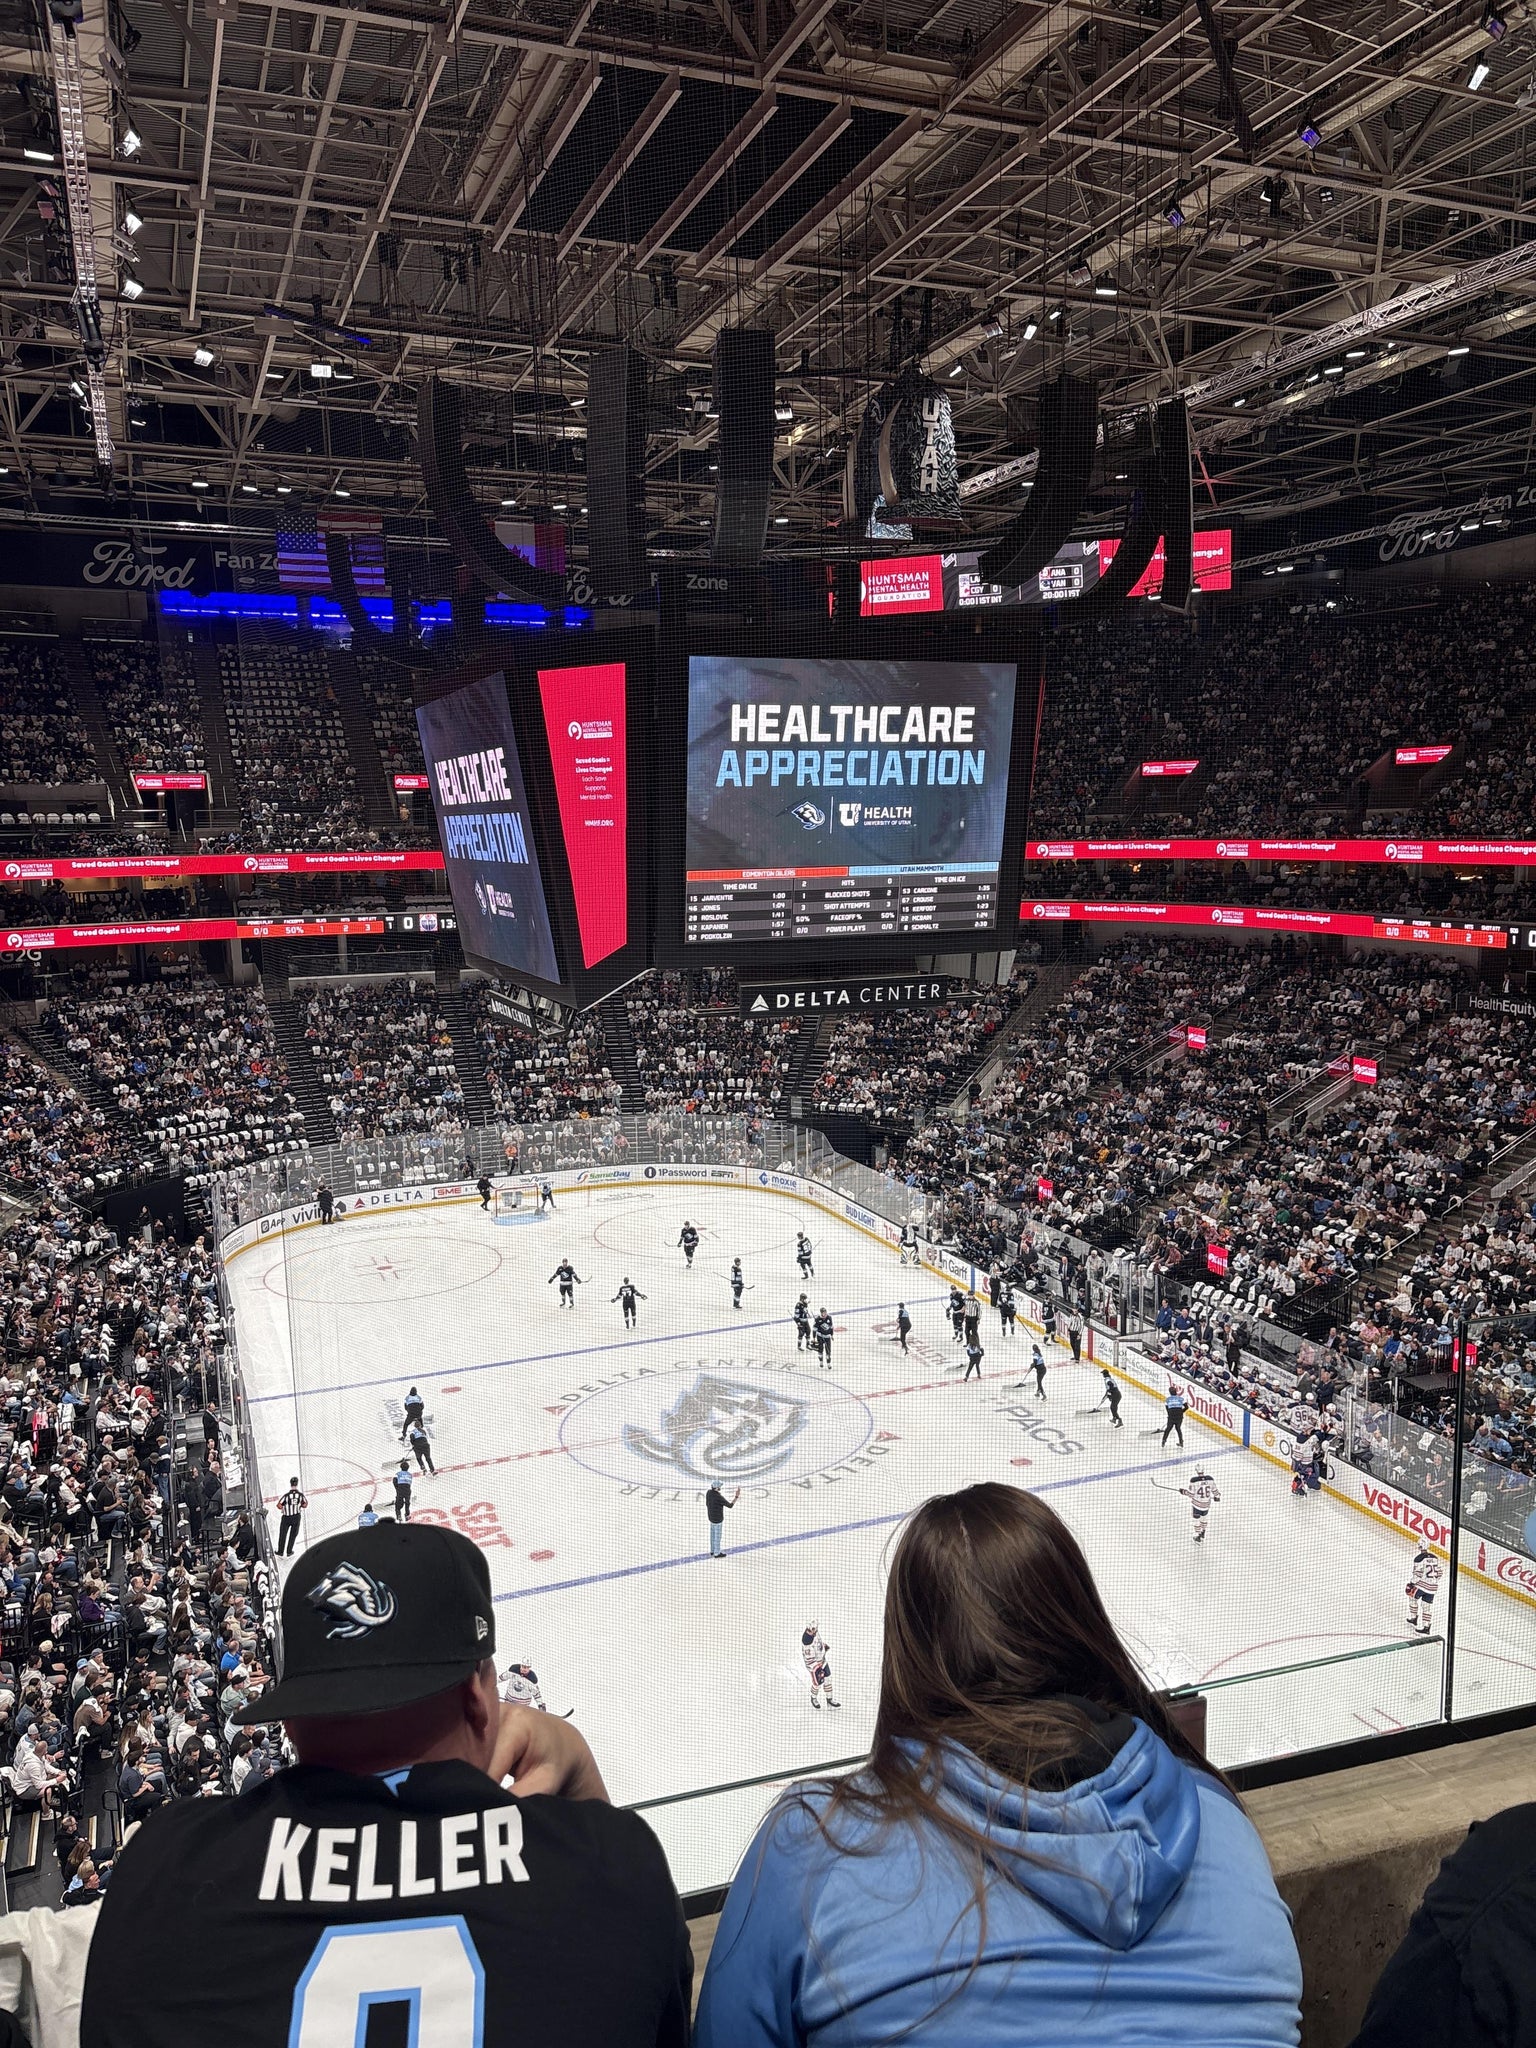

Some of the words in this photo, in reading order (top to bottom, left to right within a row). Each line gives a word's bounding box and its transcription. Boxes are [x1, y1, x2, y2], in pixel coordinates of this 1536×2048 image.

[920, 398, 940, 494] UTAH
[83, 541, 196, 588] Ford
[214, 551, 254, 569] Fan
[686, 574, 728, 590] Zone
[868, 572, 929, 585] HUNTSMAN
[869, 585, 898, 594] MENTAL
[900, 582, 929, 591] HEALTH
[731, 704, 975, 742] HEALTHCARE
[434, 747, 512, 806] HEALTHCARE
[716, 750, 985, 787] APPRECIATION
[864, 806, 912, 818] HEALTH
[444, 812, 529, 864] APPRECIATION
[1311, 843, 1336, 852] Changed
[1485, 845, 1503, 853] Lives
[145, 859, 179, 868] Changed
[373, 854, 404, 863] Changed
[1141, 907, 1166, 915] Changed
[286, 926, 304, 934] 50%
[404, 917, 413, 930] 0
[1306, 915, 1330, 924] Changed
[146, 925, 180, 935] Changed
[1386, 928, 1399, 936] 0/0
[1413, 930, 1429, 938] 50%
[776, 990, 850, 1008] DELTA
[860, 984, 940, 1002] CENTER
[496, 1000, 511, 1019] DELTA
[512, 1008, 532, 1028] CENTER
[1470, 996, 1536, 1017] HealthEquity
[658, 1168, 707, 1177] 1Password
[772, 1176, 797, 1187] moxie
[372, 1190, 423, 1205] DELTA
[437, 1187, 461, 1195] SME
[846, 1205, 857, 1218] BUD
[858, 1212, 875, 1228] LIGHT
[949, 1258, 968, 1280] Garff
[560, 1367, 656, 1402] DELTA
[674, 1359, 796, 1370] CENTER
[1187, 1384, 1233, 1429] Smith's
[1295, 1410, 1307, 1422] 96
[994, 1404, 1085, 1455] PACS
[792, 1445, 890, 1489] DELTA
[1197, 1486, 1210, 1498] 46
[452, 1501, 514, 1548] SEAT
[1426, 1565, 1438, 1578] 25
[258, 1804, 531, 1902] KELLER
